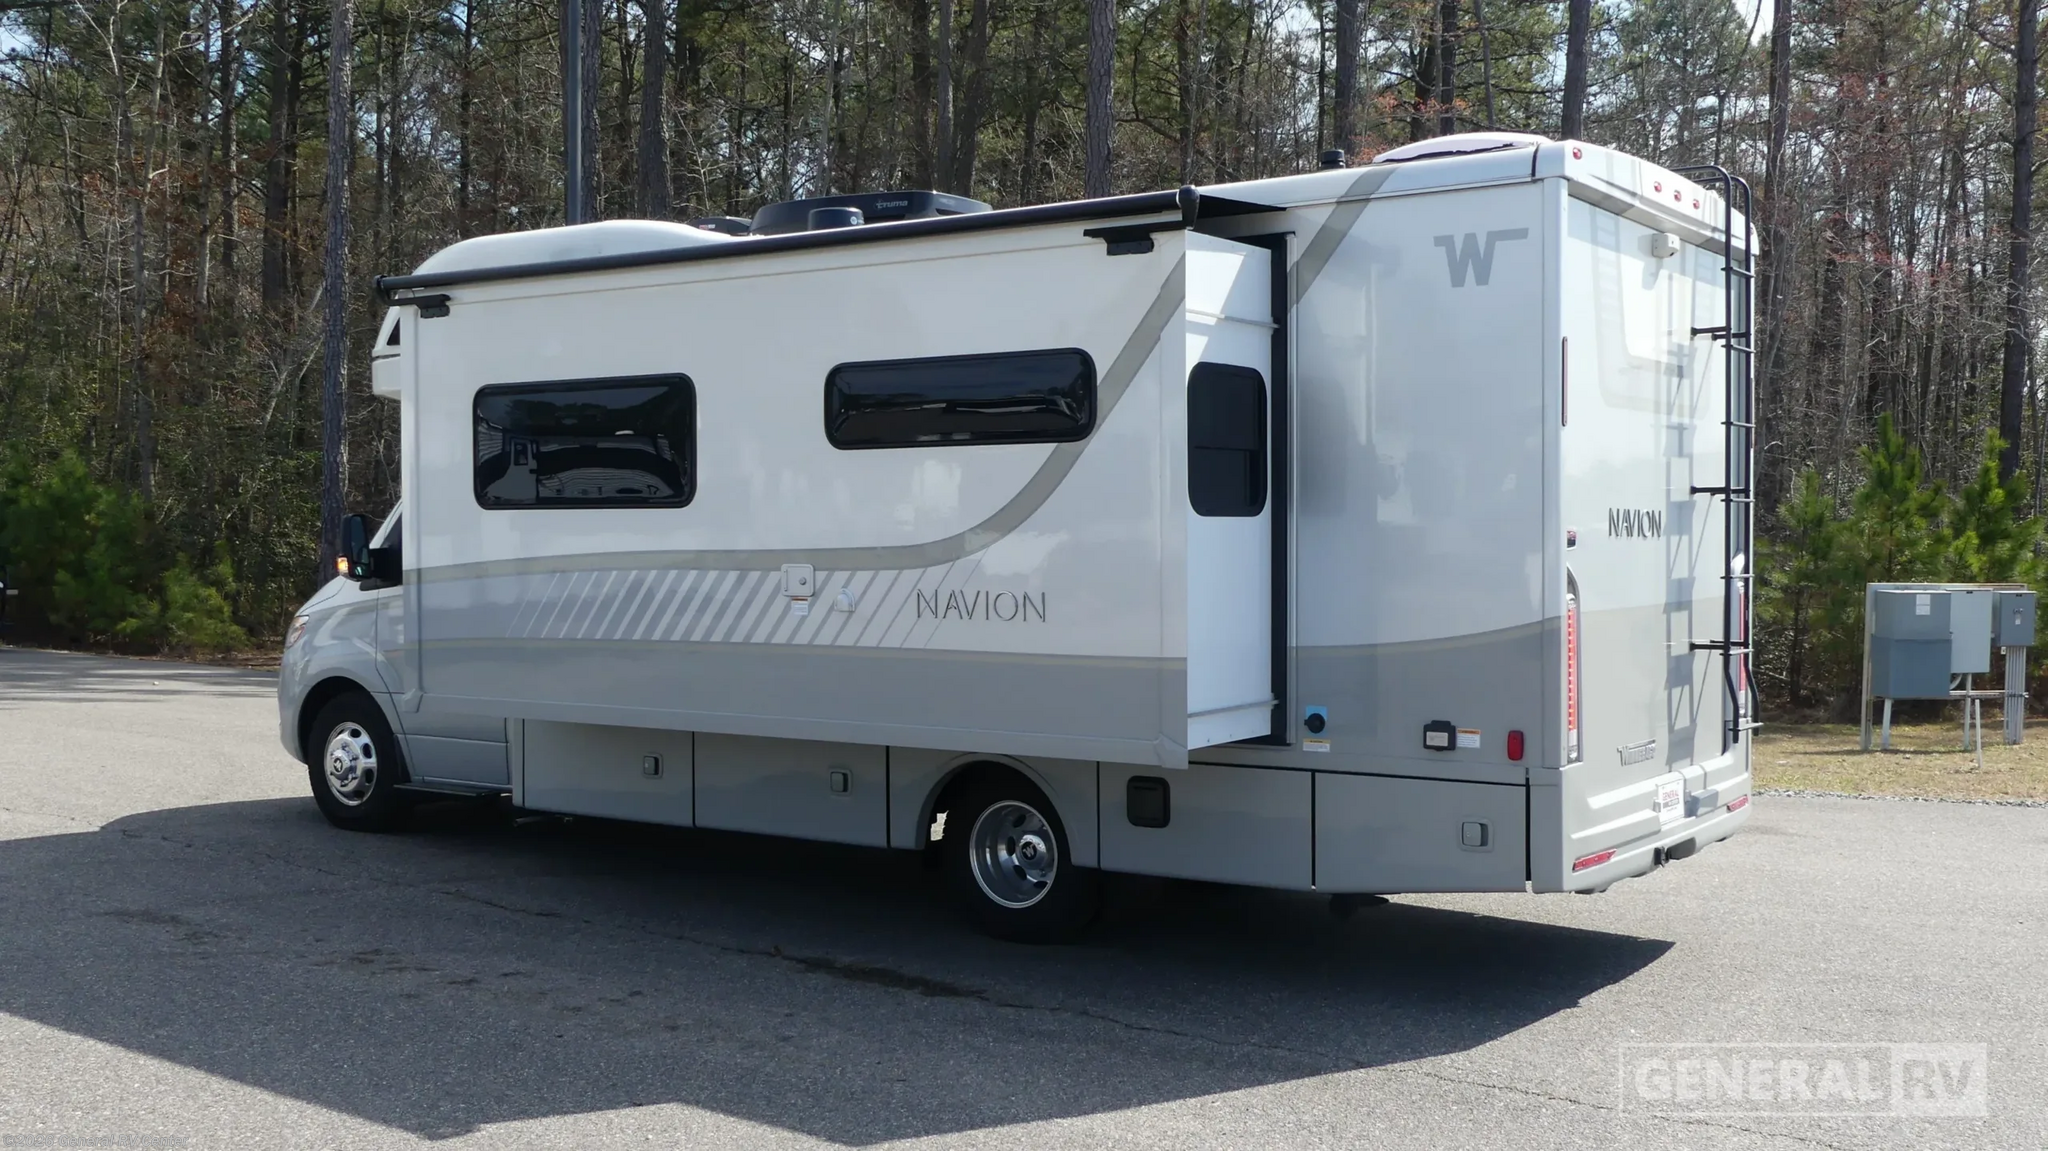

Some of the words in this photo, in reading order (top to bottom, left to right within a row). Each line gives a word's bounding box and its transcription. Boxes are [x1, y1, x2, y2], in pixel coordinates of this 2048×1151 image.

[875, 200, 908, 209] truma
[1433, 227, 1529, 288] W
[1607, 507, 1661, 538] NAVION
[917, 589, 1046, 622] NAVION
